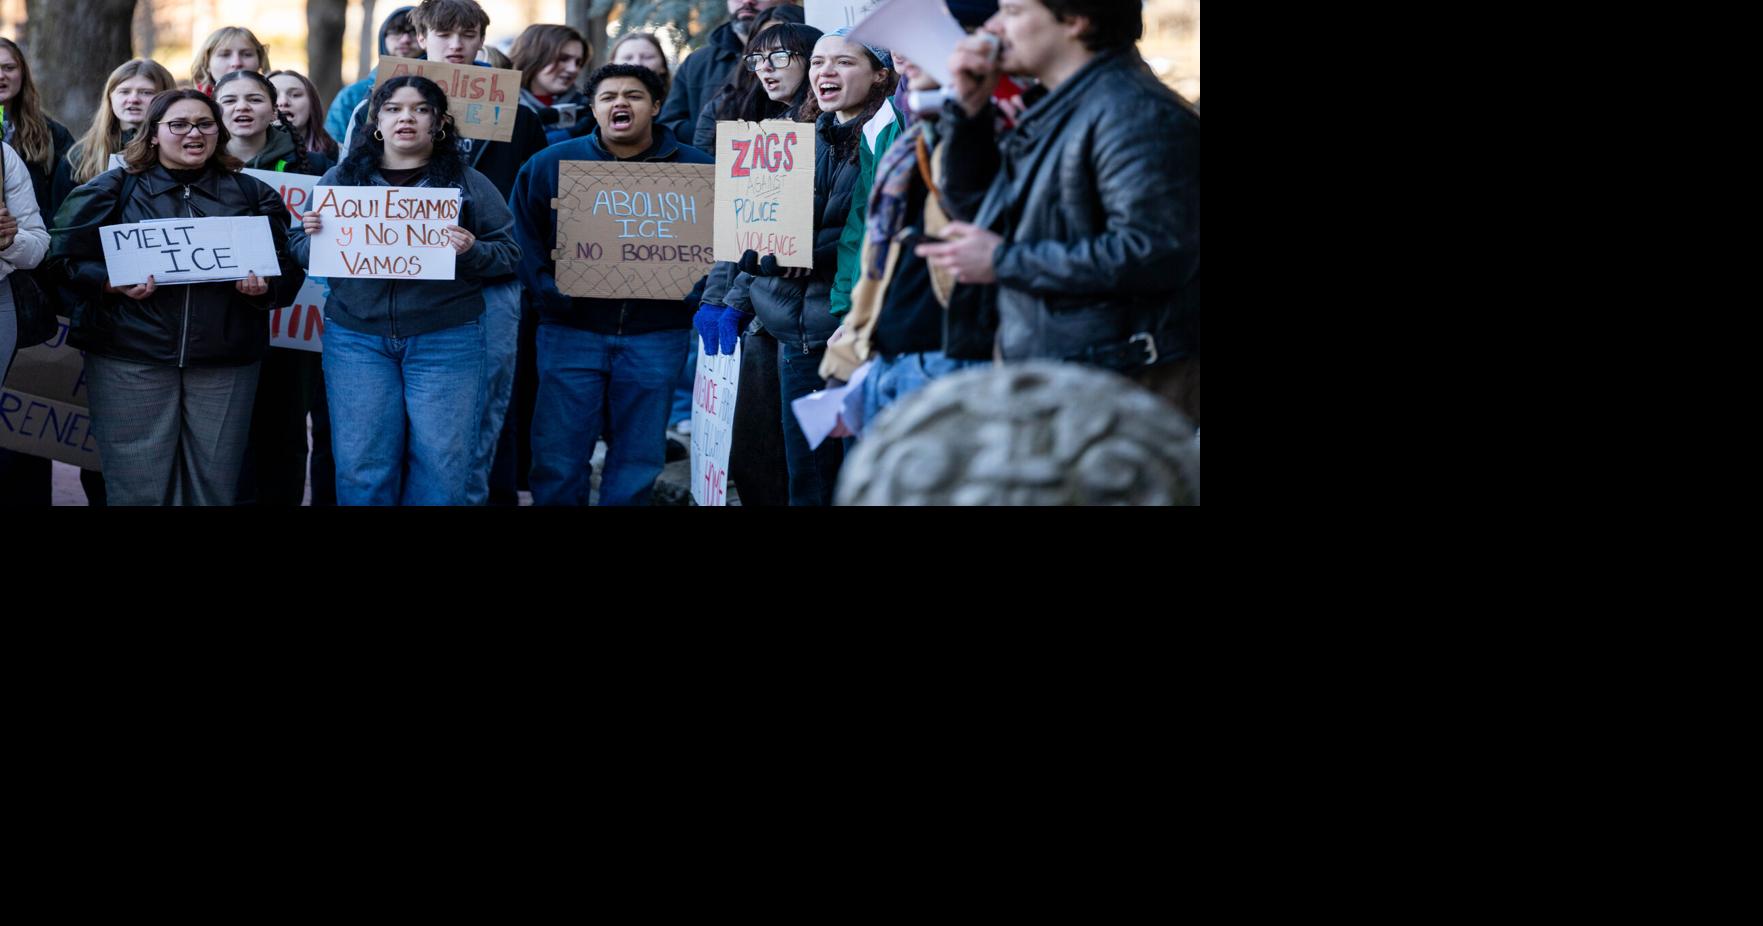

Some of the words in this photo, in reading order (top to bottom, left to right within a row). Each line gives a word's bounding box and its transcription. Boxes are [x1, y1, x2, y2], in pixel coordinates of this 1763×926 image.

[730, 131, 798, 178] ZAGS
[316, 188, 379, 219] AQUI
[385, 189, 458, 219] ESTAMOS
[592, 190, 697, 224] ABOLISH
[734, 198, 780, 229] POLICE
[113, 226, 194, 250] MELT
[365, 222, 399, 246] NO
[406, 223, 451, 248] NOS
[736, 231, 798, 256] VIOLENCE
[160, 247, 239, 274] ICE
[340, 250, 422, 276] VAMOS
[576, 242, 603, 261] NO
[622, 243, 714, 264] BORDERS
